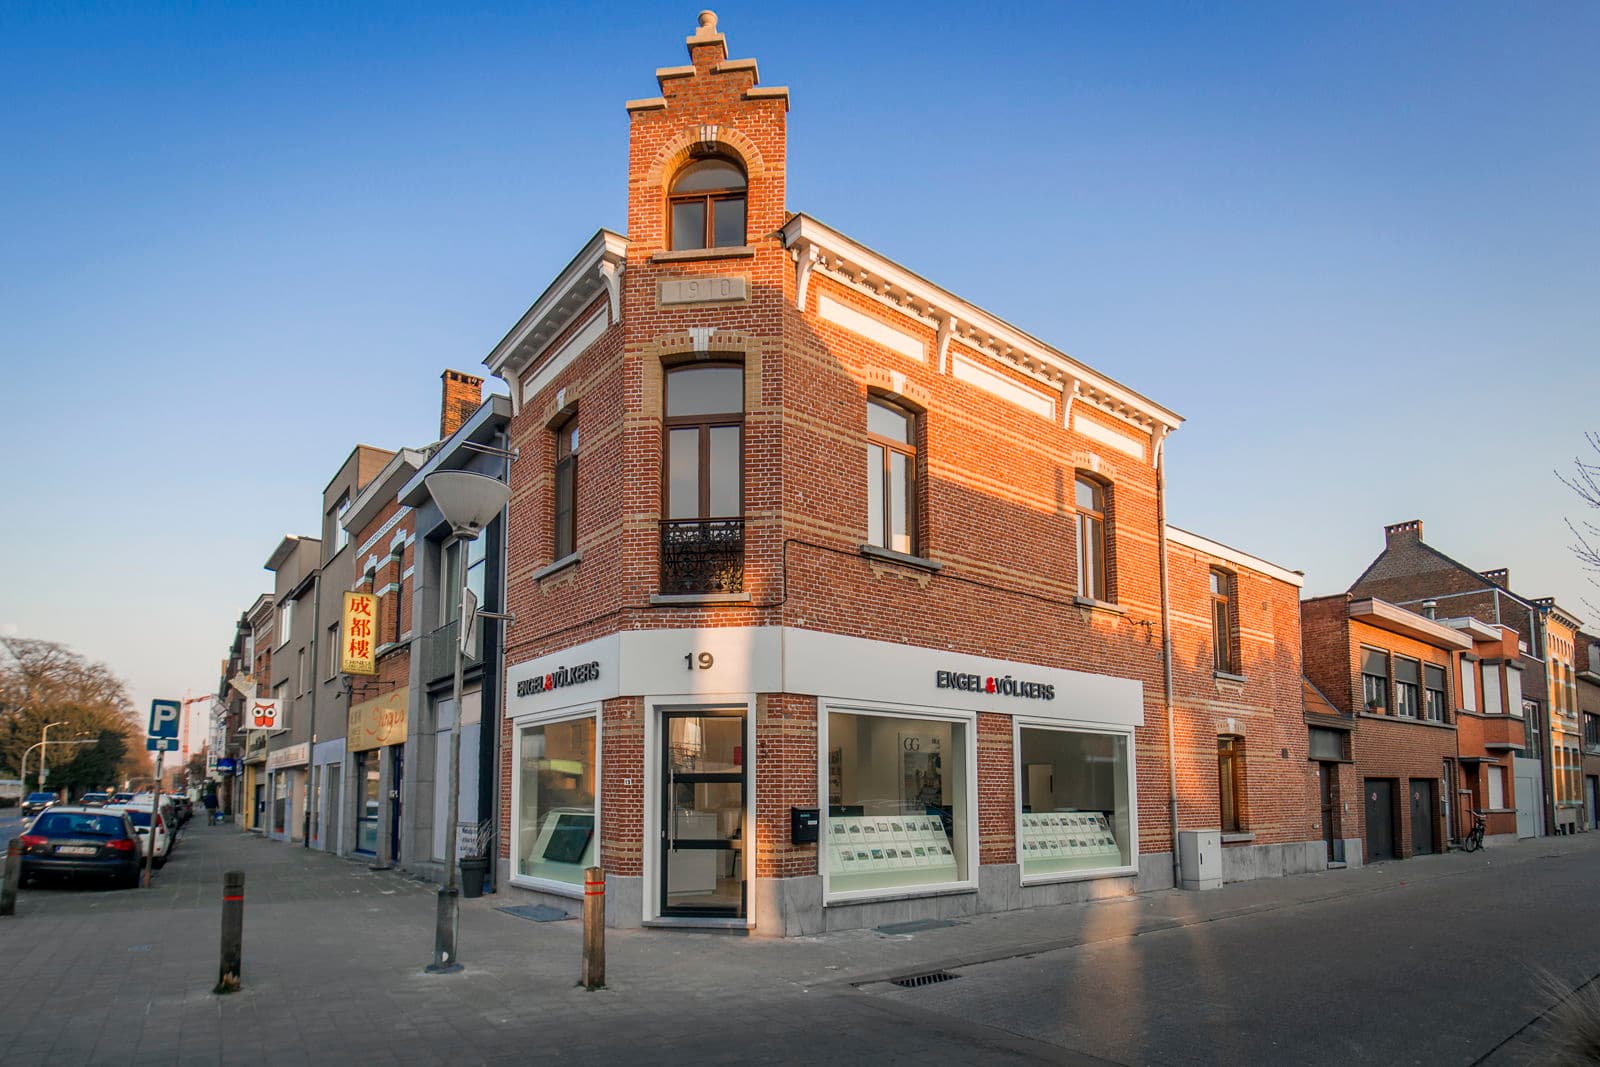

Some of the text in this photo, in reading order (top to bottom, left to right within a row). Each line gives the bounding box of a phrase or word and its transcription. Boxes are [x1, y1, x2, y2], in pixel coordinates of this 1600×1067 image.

[678, 278, 731, 300] 1910
[349, 595, 372, 660] 成都樓
[684, 652, 714, 670] 19
[936, 670, 1056, 701] ENGEL&VÖLKERS
[152, 704, 177, 732] P
